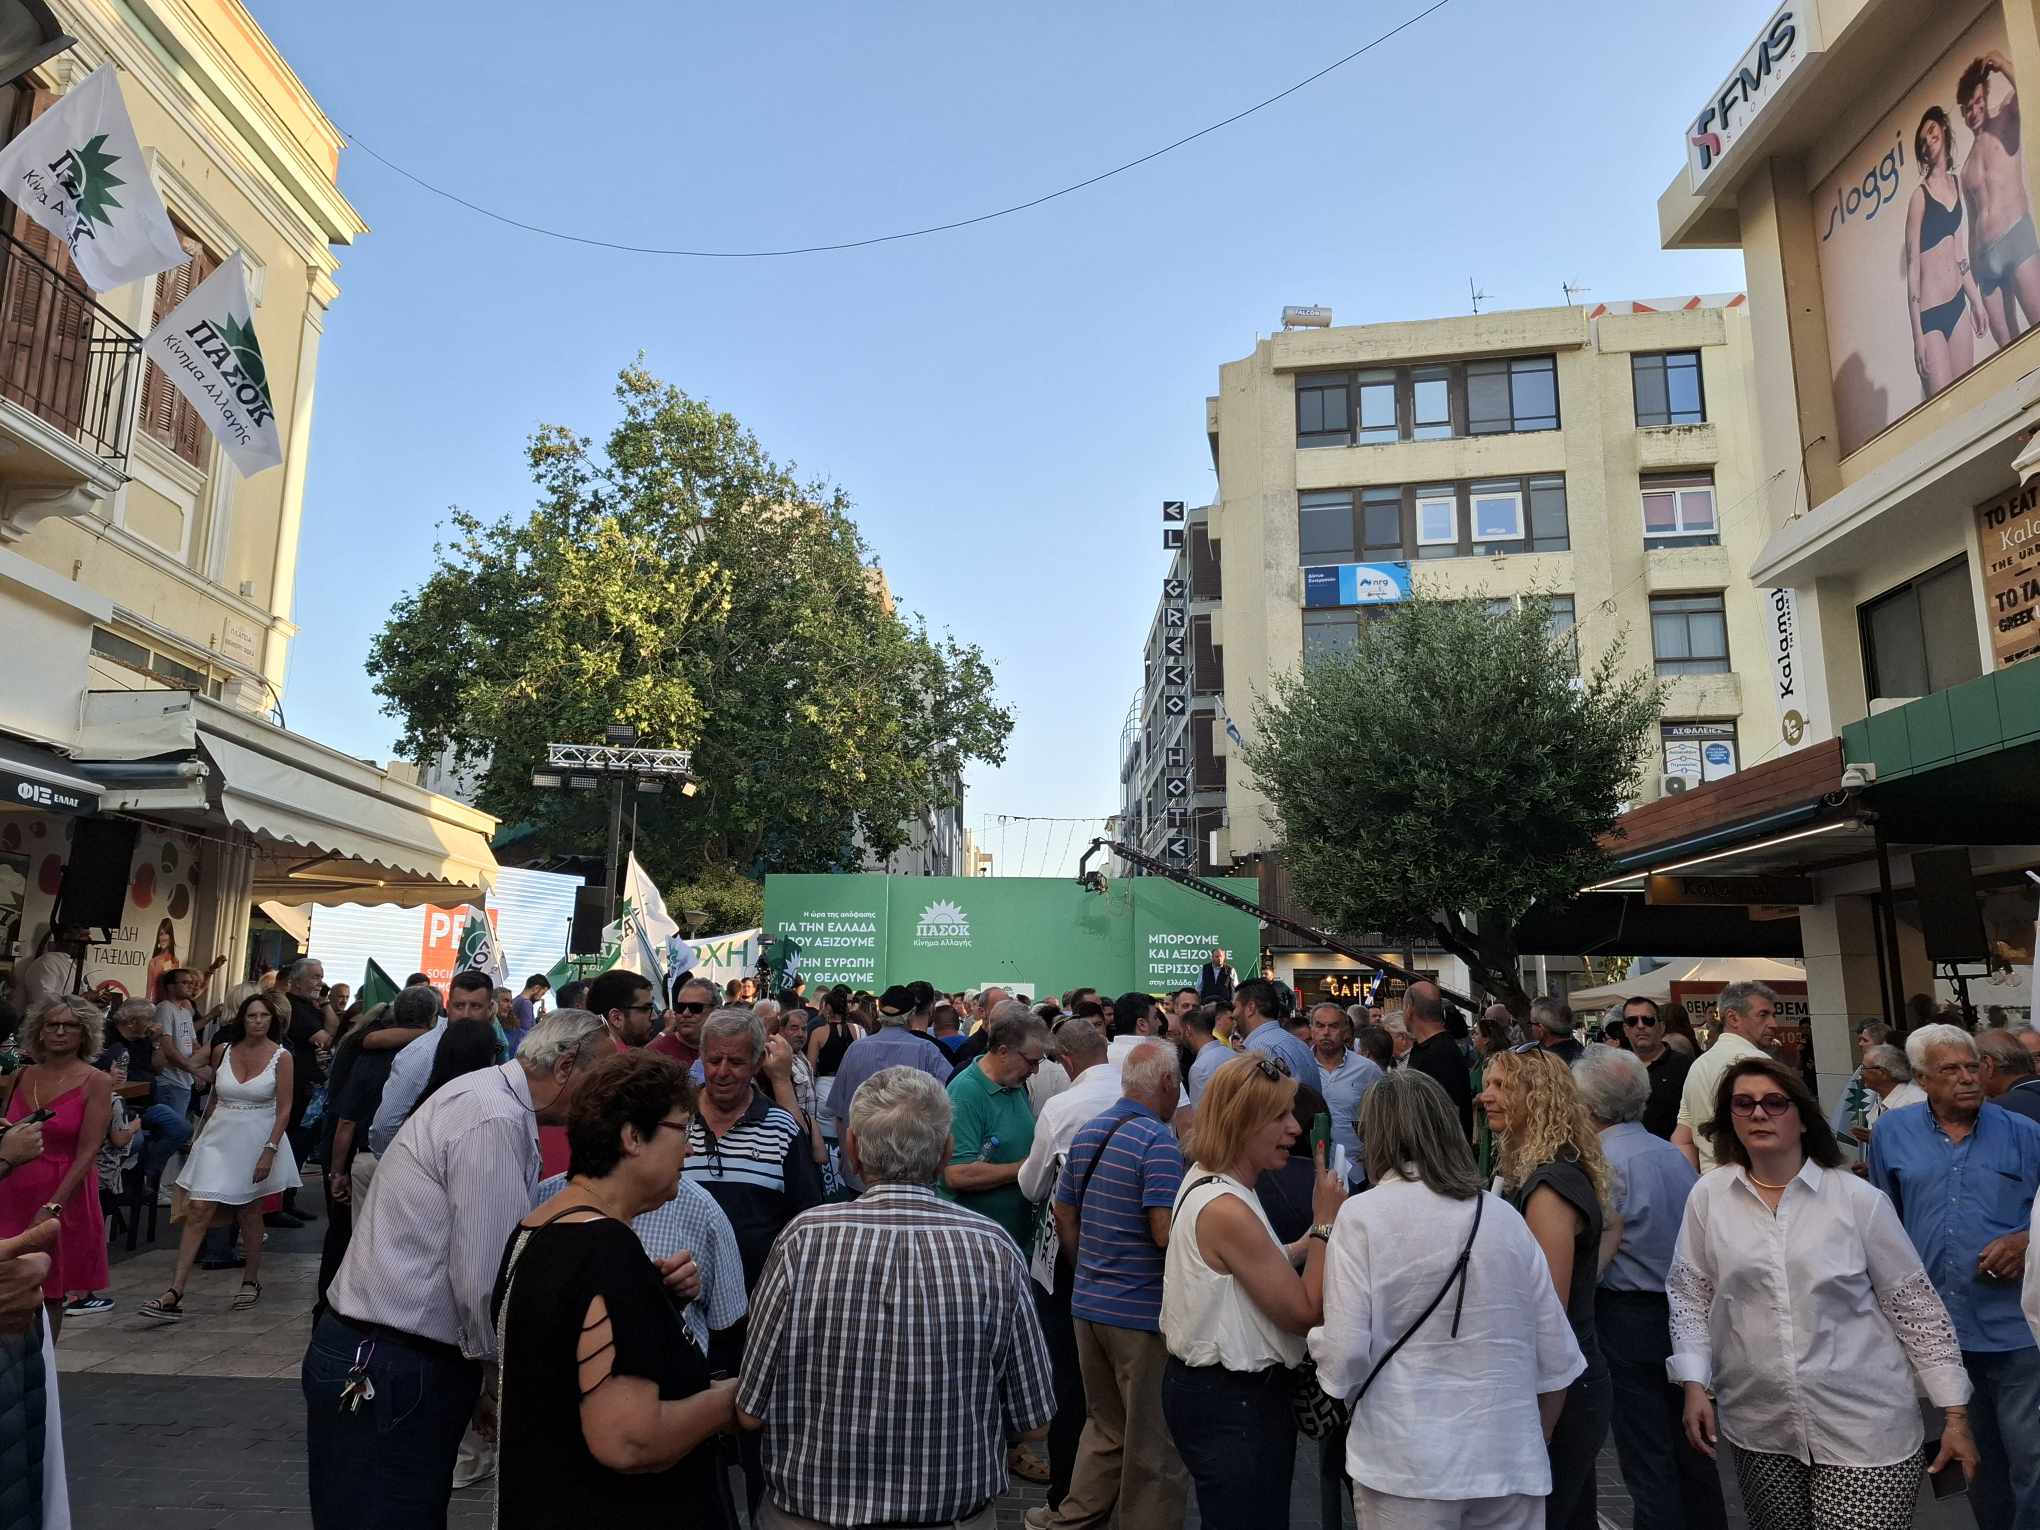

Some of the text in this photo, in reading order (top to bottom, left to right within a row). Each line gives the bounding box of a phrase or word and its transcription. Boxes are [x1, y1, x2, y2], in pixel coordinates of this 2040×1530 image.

[1823, 129, 1904, 242] sloggi
[185, 320, 274, 428] ΠΑΣΟΚ
[162, 334, 252, 446] Κίνημα Αλλαγής
[1984, 487, 2039, 530] TO EAT
[1992, 556, 2014, 573] THE
[1373, 578, 1388, 586] nrg
[1995, 588, 2018, 612] TO
[2019, 578, 2040, 601] TA
[1771, 588, 1794, 699] Kalama
[17, 782, 79, 808] ΦΙΞ ΕΛΛΑΣ
[778, 922, 876, 932] ΓΙΑ ΤΗΝ ΕΛΛΑΔΑ
[916, 925, 971, 936] ΠΑΣΟΚ
[814, 937, 875, 947] ΑΞΙΖΟΥΜΕ
[914, 938, 972, 948] Κίνημα Αλλαγής
[1148, 934, 1220, 945] ΜΠΟΡΟΥΜΕ
[94, 946, 147, 967] ΤΑΞΙΔΙΟΥ
[1149, 949, 1233, 960] ΚΑΙ ΑΞΙΖΟΥΕ
[824, 958, 874, 968] ΕΥΡΩΠΗ
[1149, 963, 1203, 974] ΠΕΡΙΣΣΟ
[814, 972, 874, 982] ΘΕΛΟΥΜΕ
[1330, 983, 1372, 997] CAFE
[1775, 1002, 1808, 1015] ΘΕΜ
